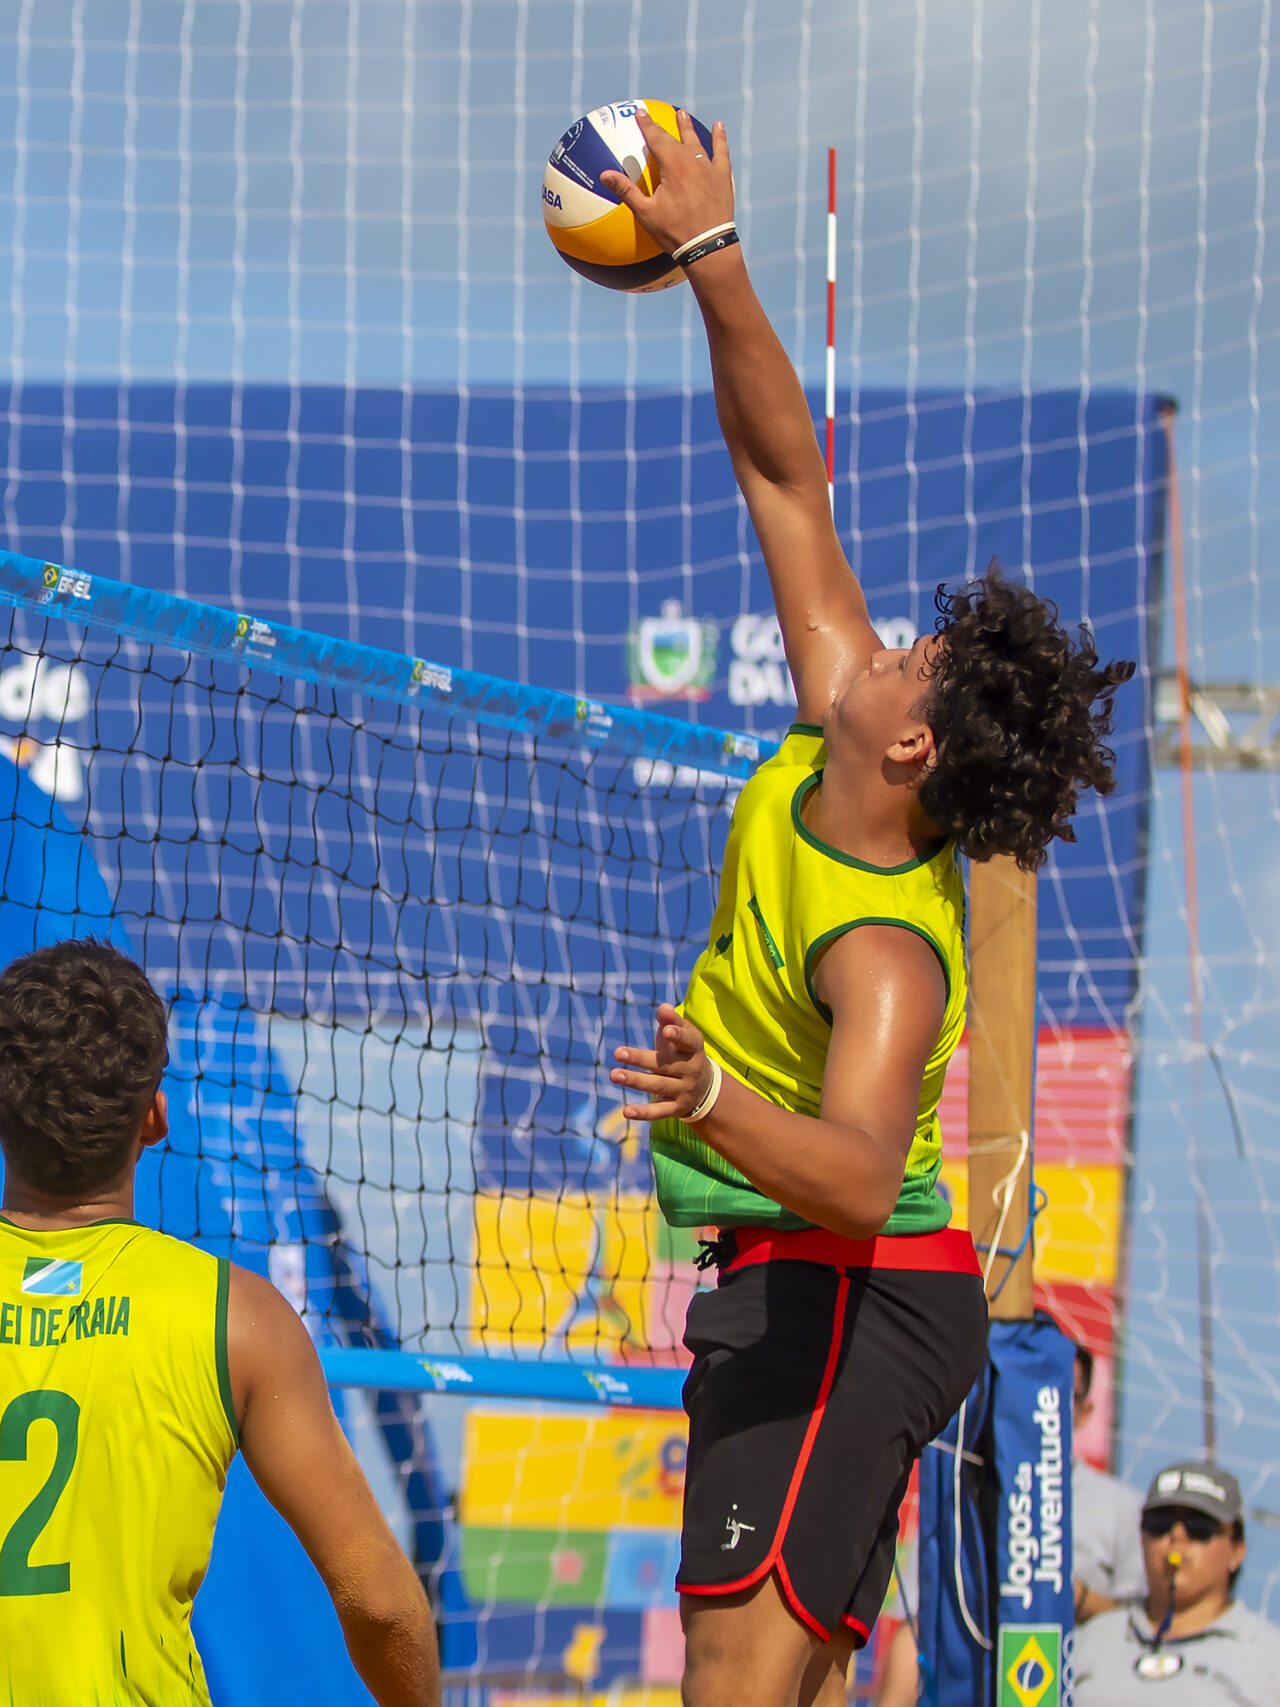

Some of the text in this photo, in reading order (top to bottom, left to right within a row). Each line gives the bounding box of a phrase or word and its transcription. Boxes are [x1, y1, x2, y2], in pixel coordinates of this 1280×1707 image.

[542, 184, 563, 210] ASA
[30, 1307, 62, 1347] DE
[999, 1461, 1040, 1610] Jogos da
[1033, 1386, 1063, 1595] Juventude
